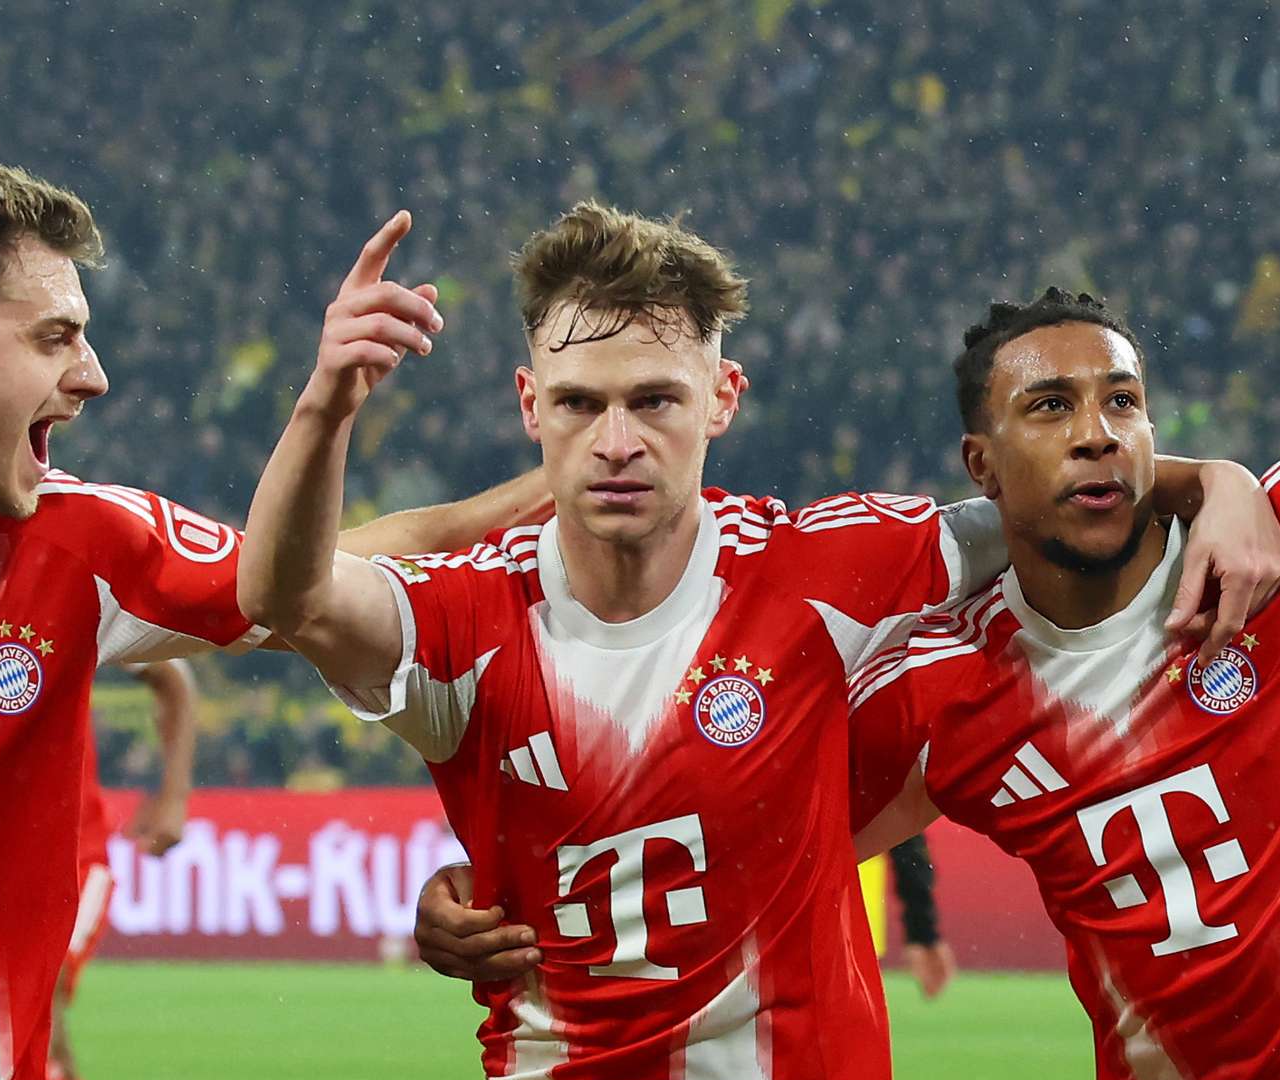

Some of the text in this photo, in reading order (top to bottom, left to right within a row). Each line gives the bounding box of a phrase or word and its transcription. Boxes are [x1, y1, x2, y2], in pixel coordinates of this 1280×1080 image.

[1191, 668, 1202, 685] FC
[700, 680, 757, 713] FC BAYERN
